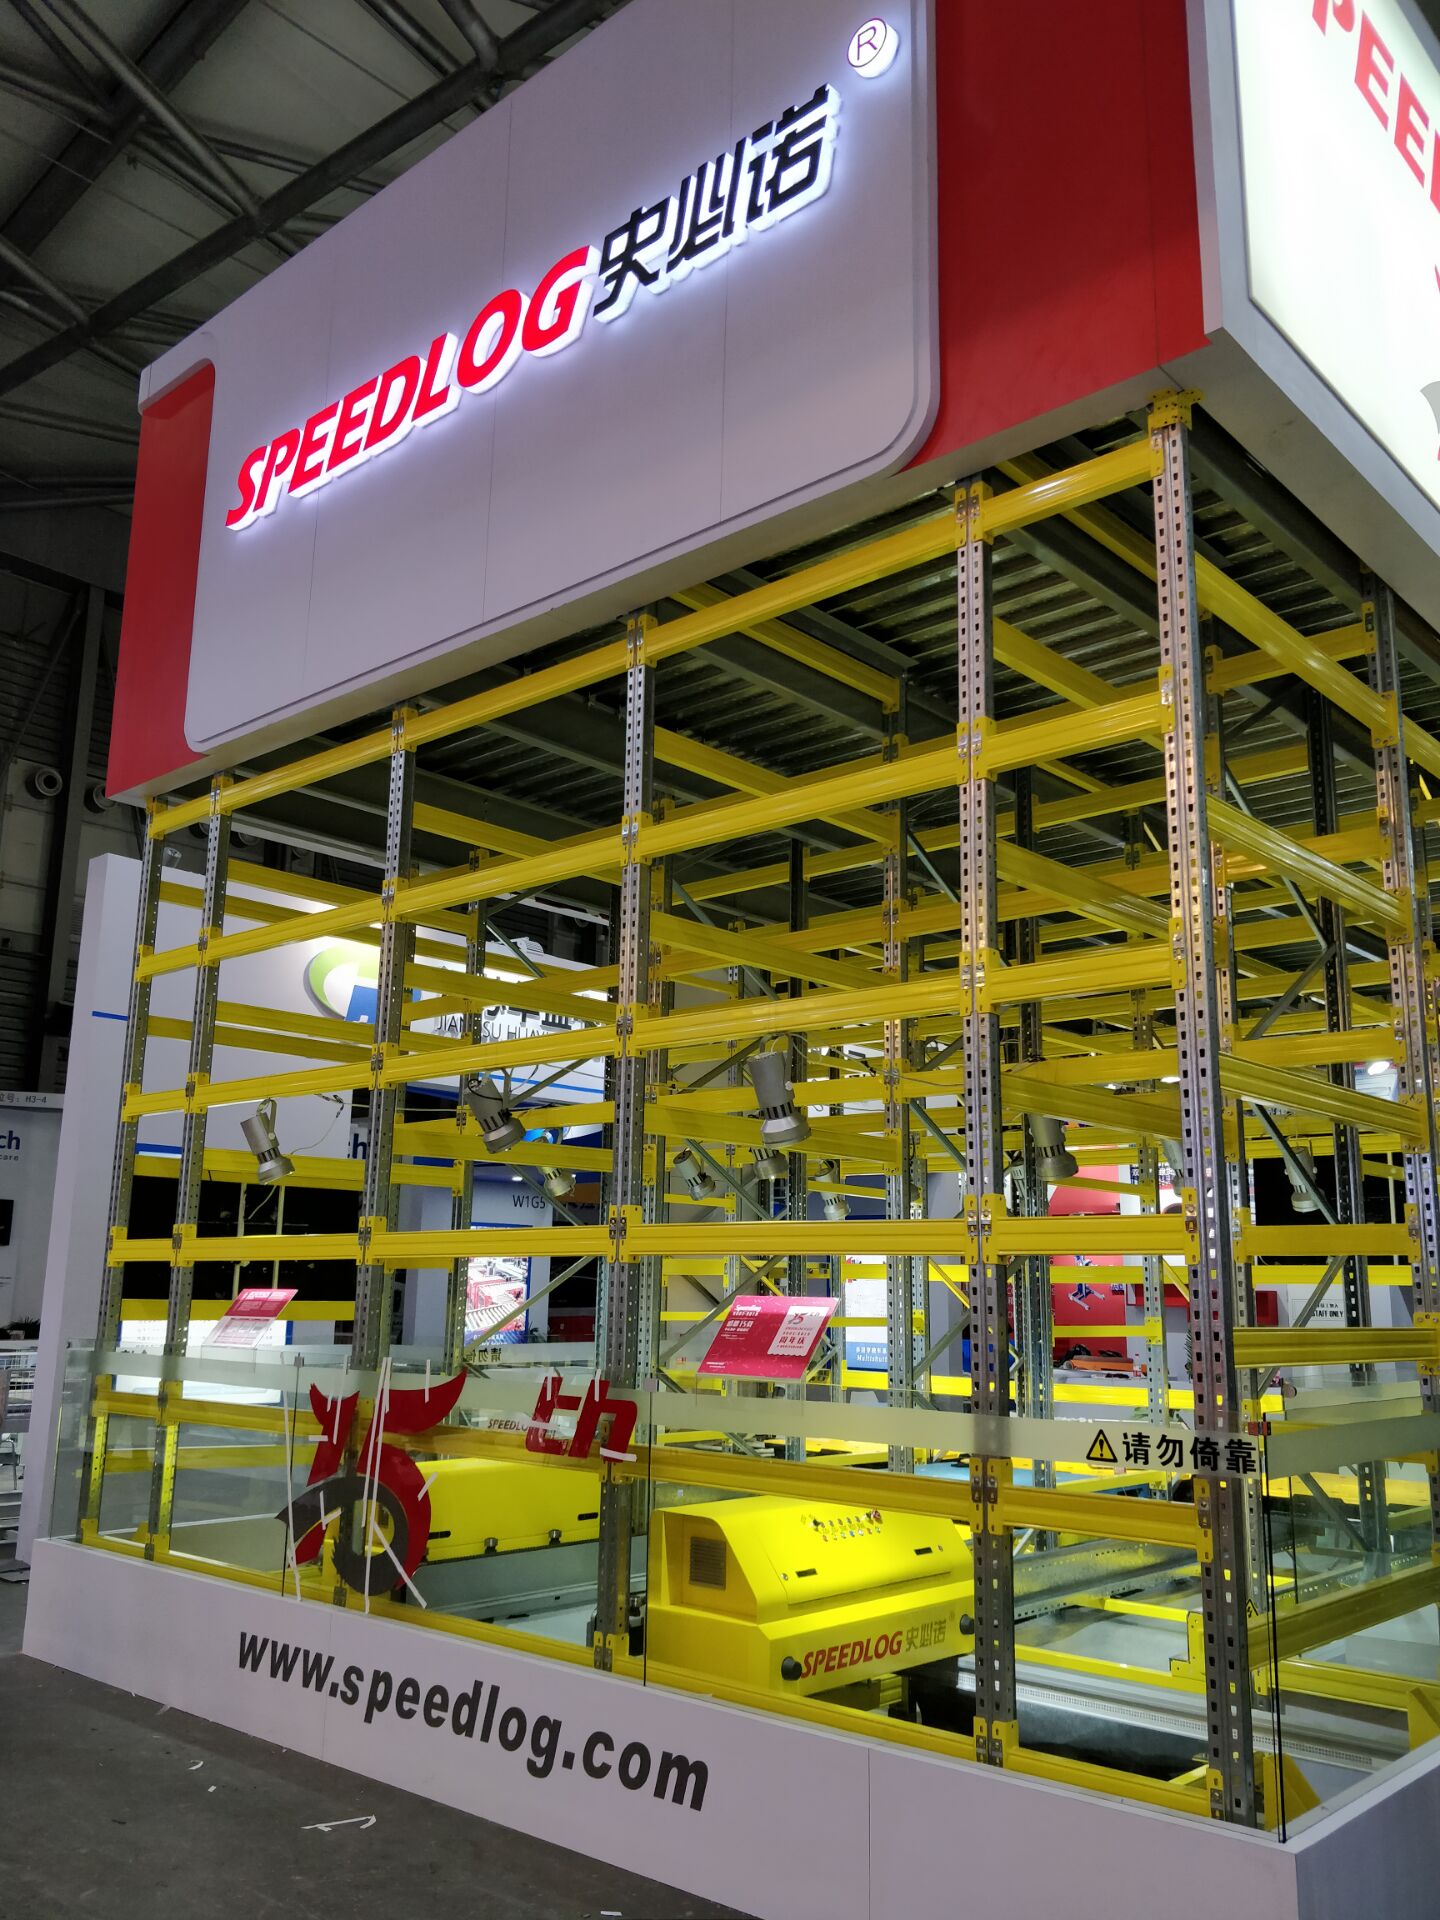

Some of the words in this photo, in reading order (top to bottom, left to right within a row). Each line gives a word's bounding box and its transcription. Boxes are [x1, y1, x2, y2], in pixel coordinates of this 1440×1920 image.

[226, 245, 592, 528] SPEEDLOG
[594, 84, 834, 319] 史必诺
[1122, 1432, 1257, 1474] 请勿倚靠
[801, 1631, 903, 1678] SPEEDLOG
[239, 1630, 708, 1811] www.speedlog.com
